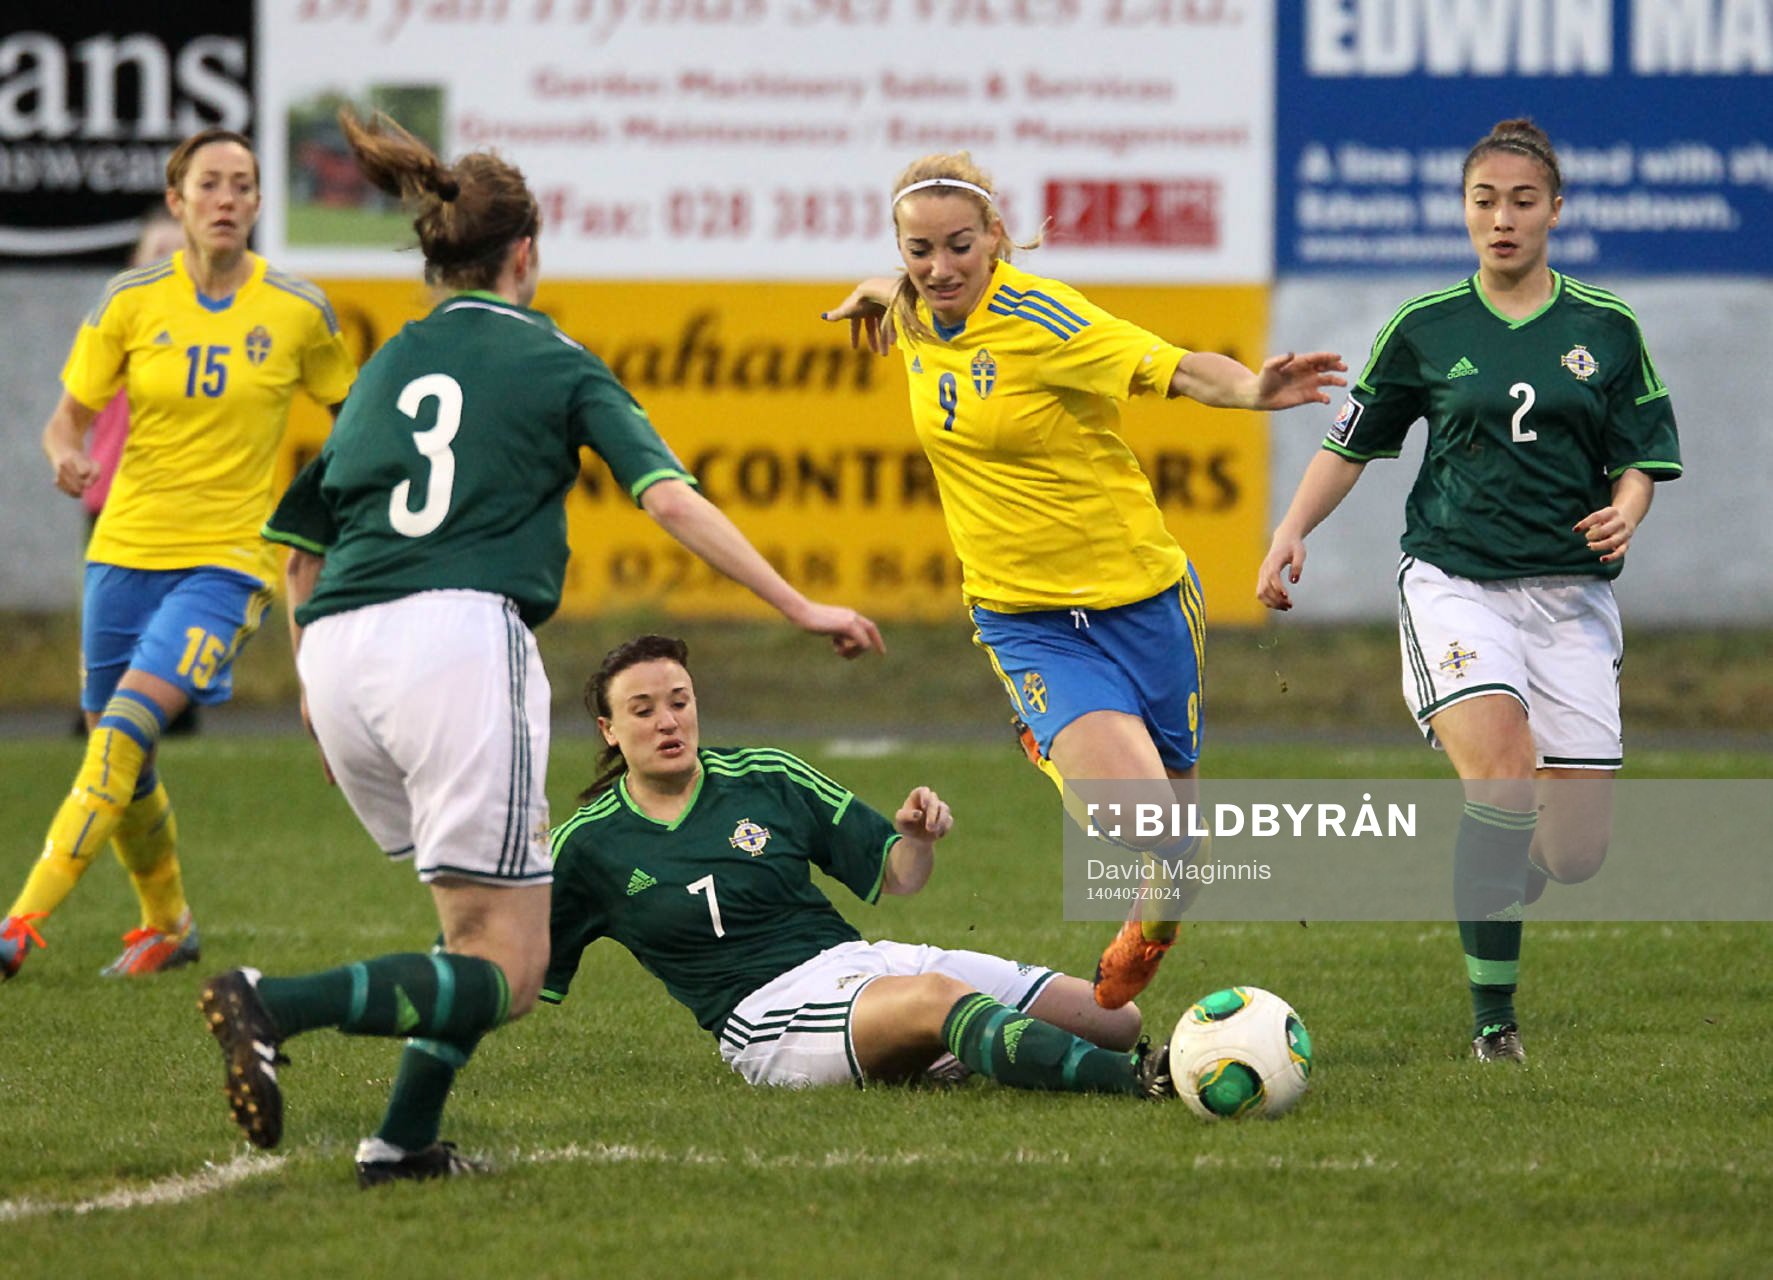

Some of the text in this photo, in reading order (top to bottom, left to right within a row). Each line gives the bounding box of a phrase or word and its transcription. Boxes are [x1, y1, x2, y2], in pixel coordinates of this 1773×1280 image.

[1304, 0, 1613, 77] EDWIN
[185, 345, 231, 398] 15
[939, 372, 958, 432] 9
[1508, 382, 1537, 443] 2
[389, 373, 463, 538] 3
[176, 626, 227, 690] 15
[686, 874, 726, 938] 7
